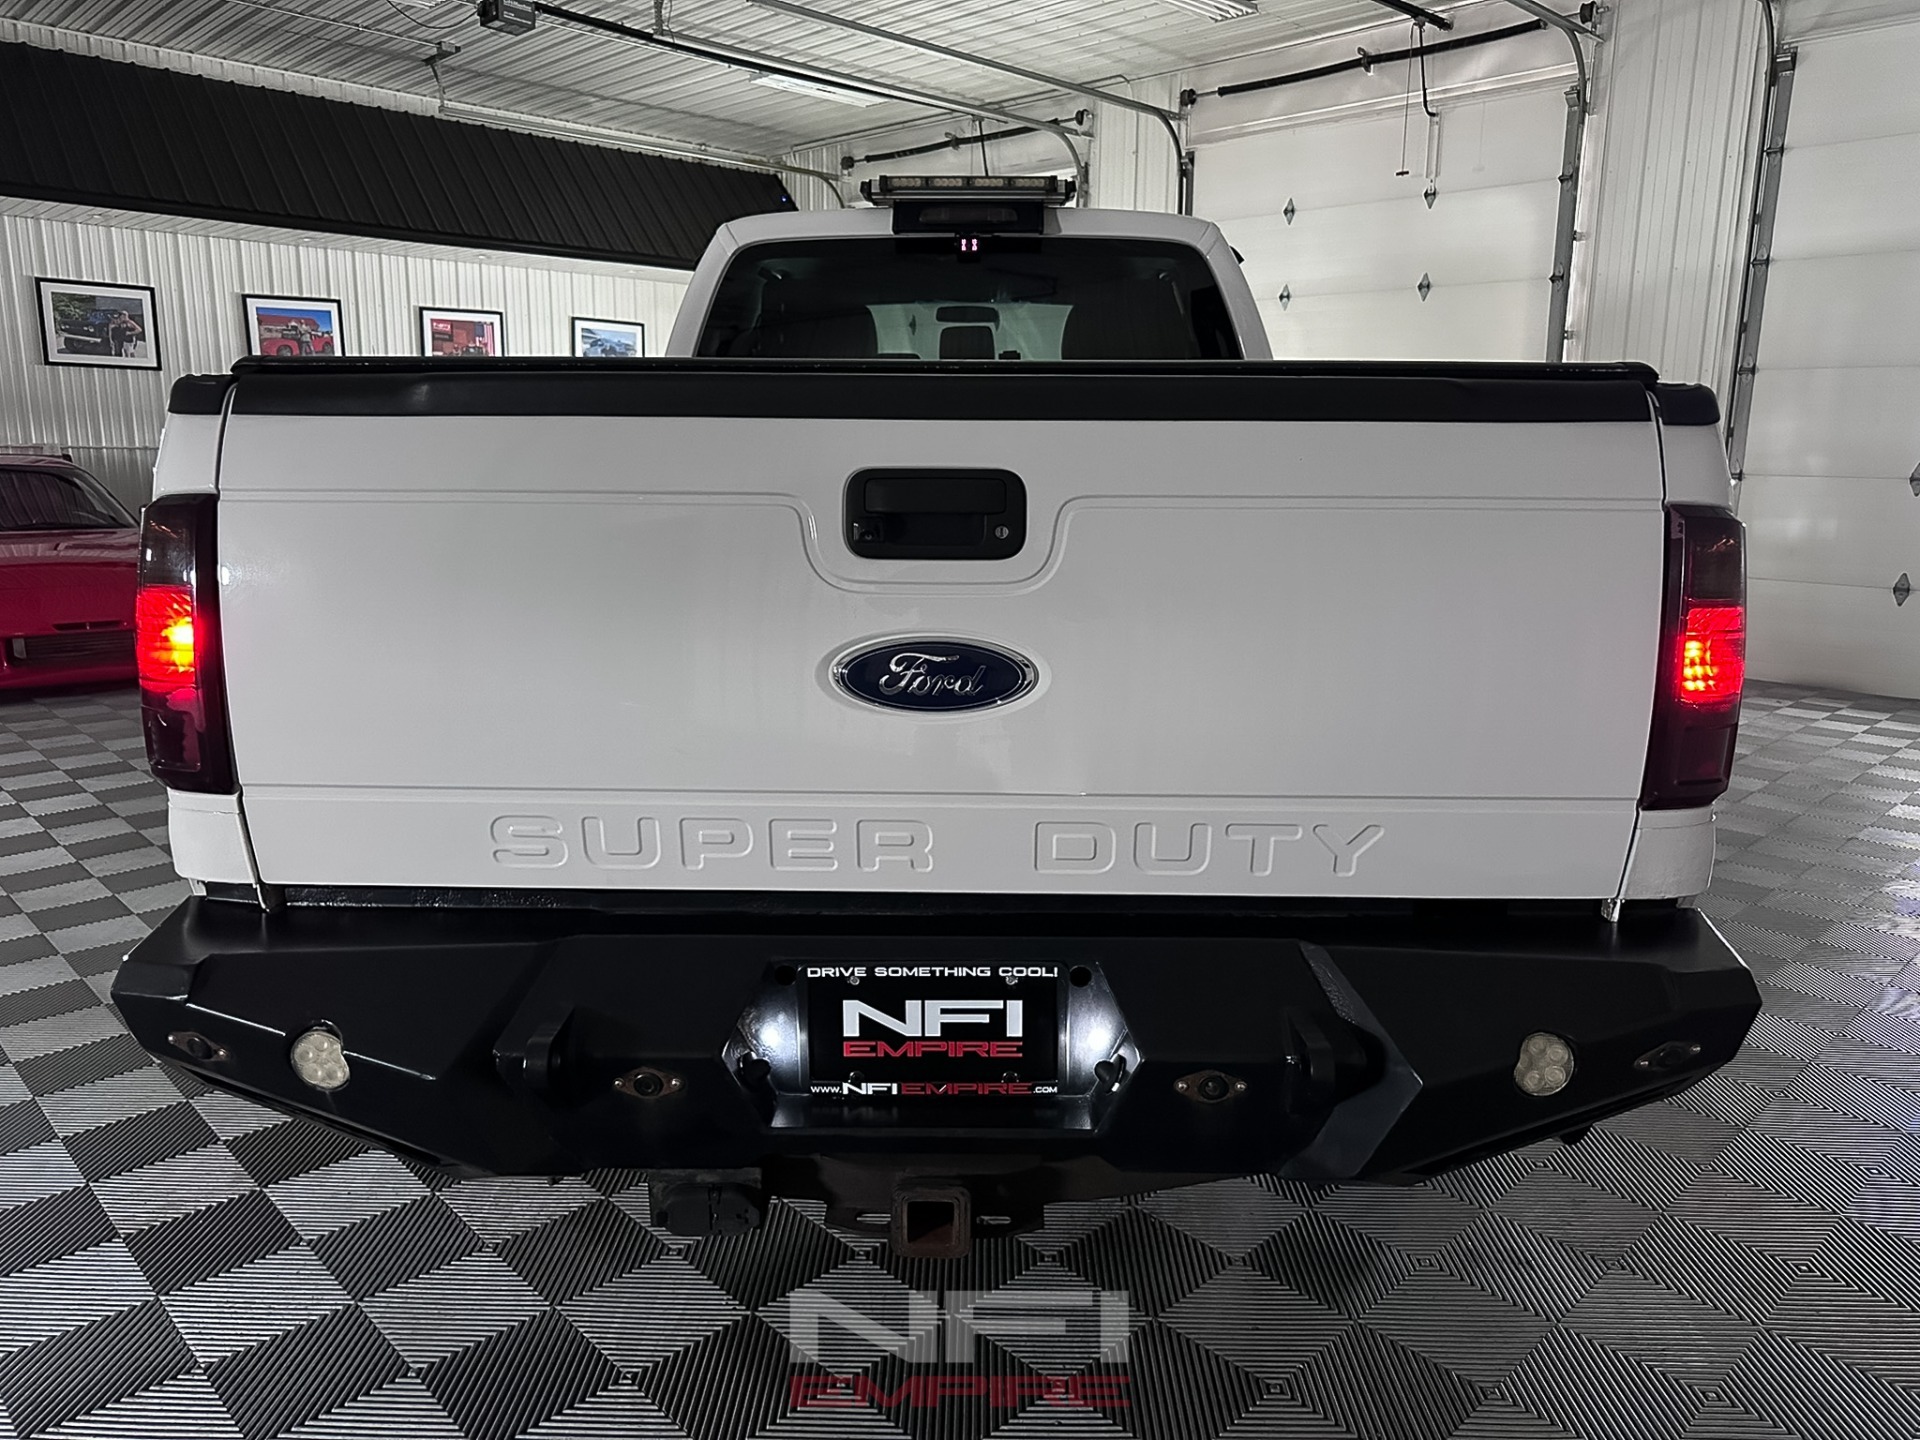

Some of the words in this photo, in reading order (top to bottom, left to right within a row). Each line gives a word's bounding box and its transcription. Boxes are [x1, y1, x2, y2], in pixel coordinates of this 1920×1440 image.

[878, 652, 987, 696] Ford
[490, 815, 933, 872] SUPER
[1034, 821, 1385, 877] DUTY
[807, 967, 867, 978] DRIVE
[874, 967, 991, 977] SOMETHING
[998, 967, 1058, 978] COOL!
[842, 999, 1023, 1037] NFI
[842, 1041, 1023, 1058] EMPIRE
